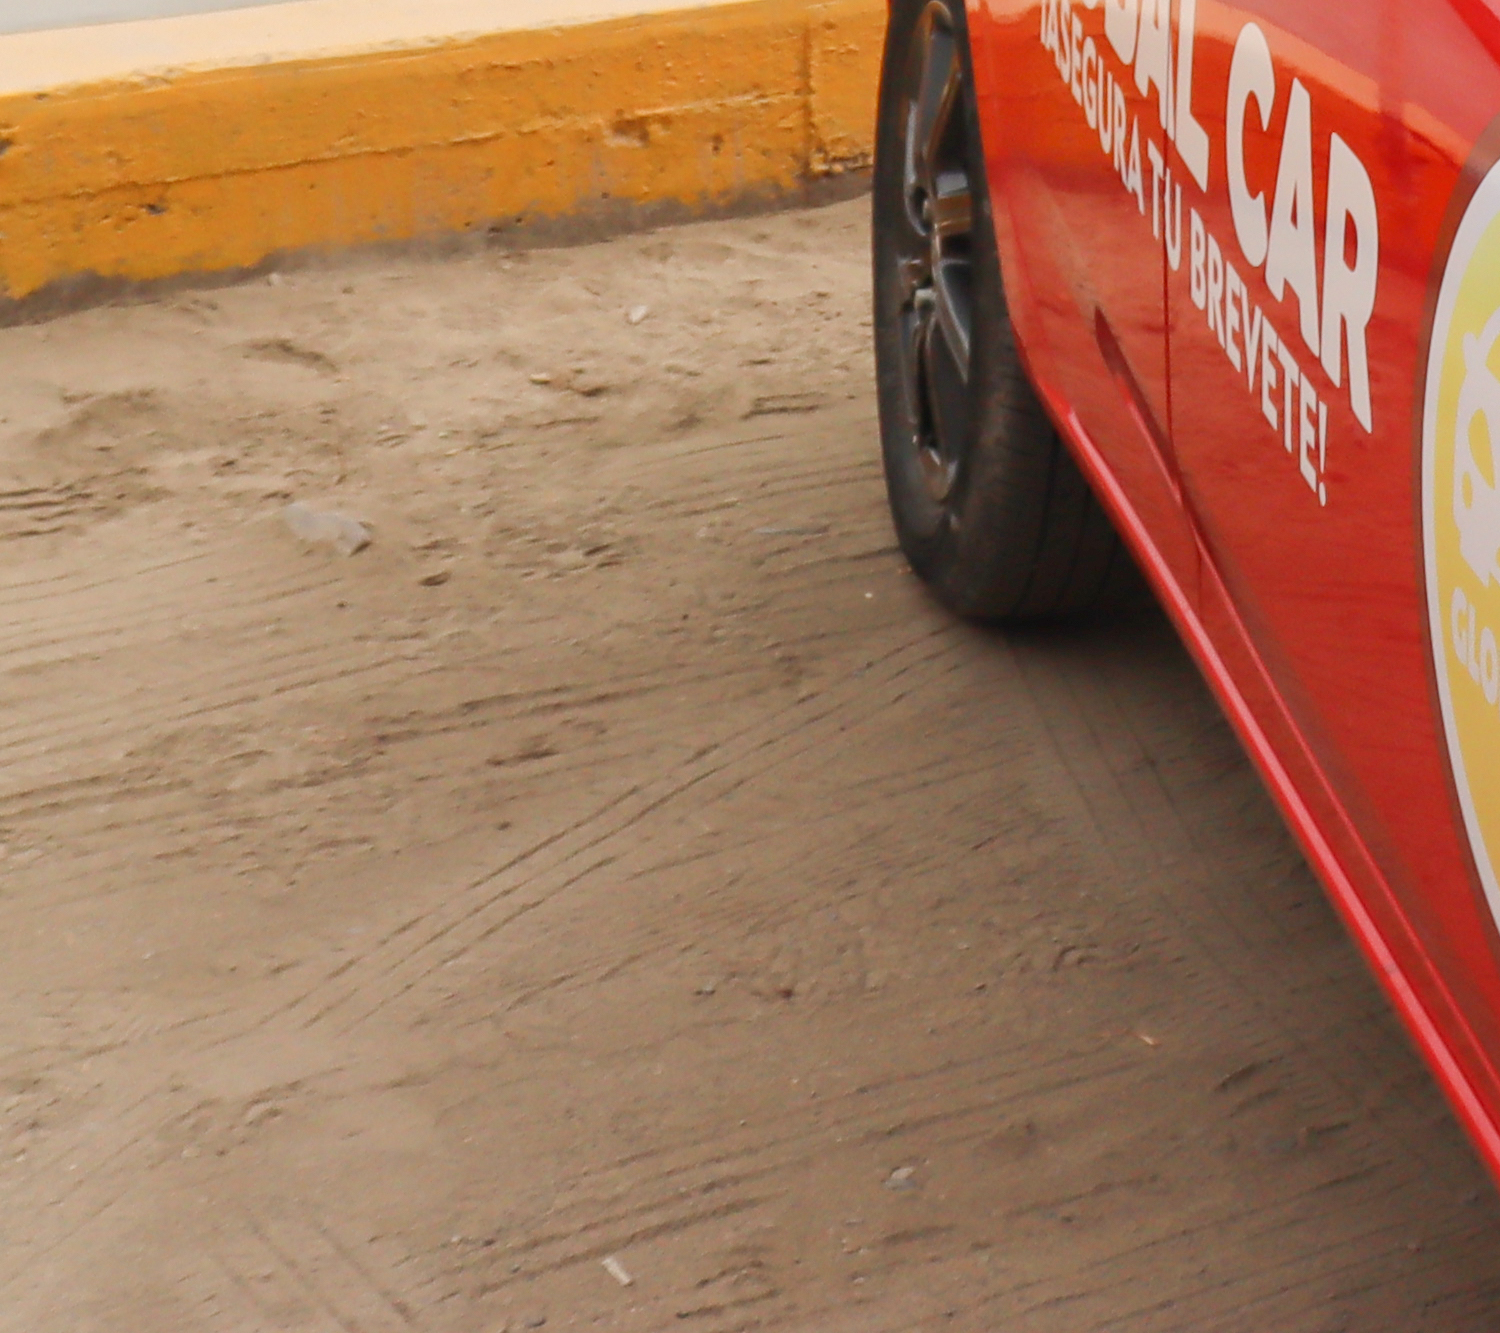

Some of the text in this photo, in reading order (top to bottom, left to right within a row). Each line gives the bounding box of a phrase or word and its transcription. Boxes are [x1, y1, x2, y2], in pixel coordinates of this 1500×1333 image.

[1148, 137, 1182, 272] TU
[1190, 207, 1327, 507] BREVETE!
[1226, 22, 1379, 434] CAR
